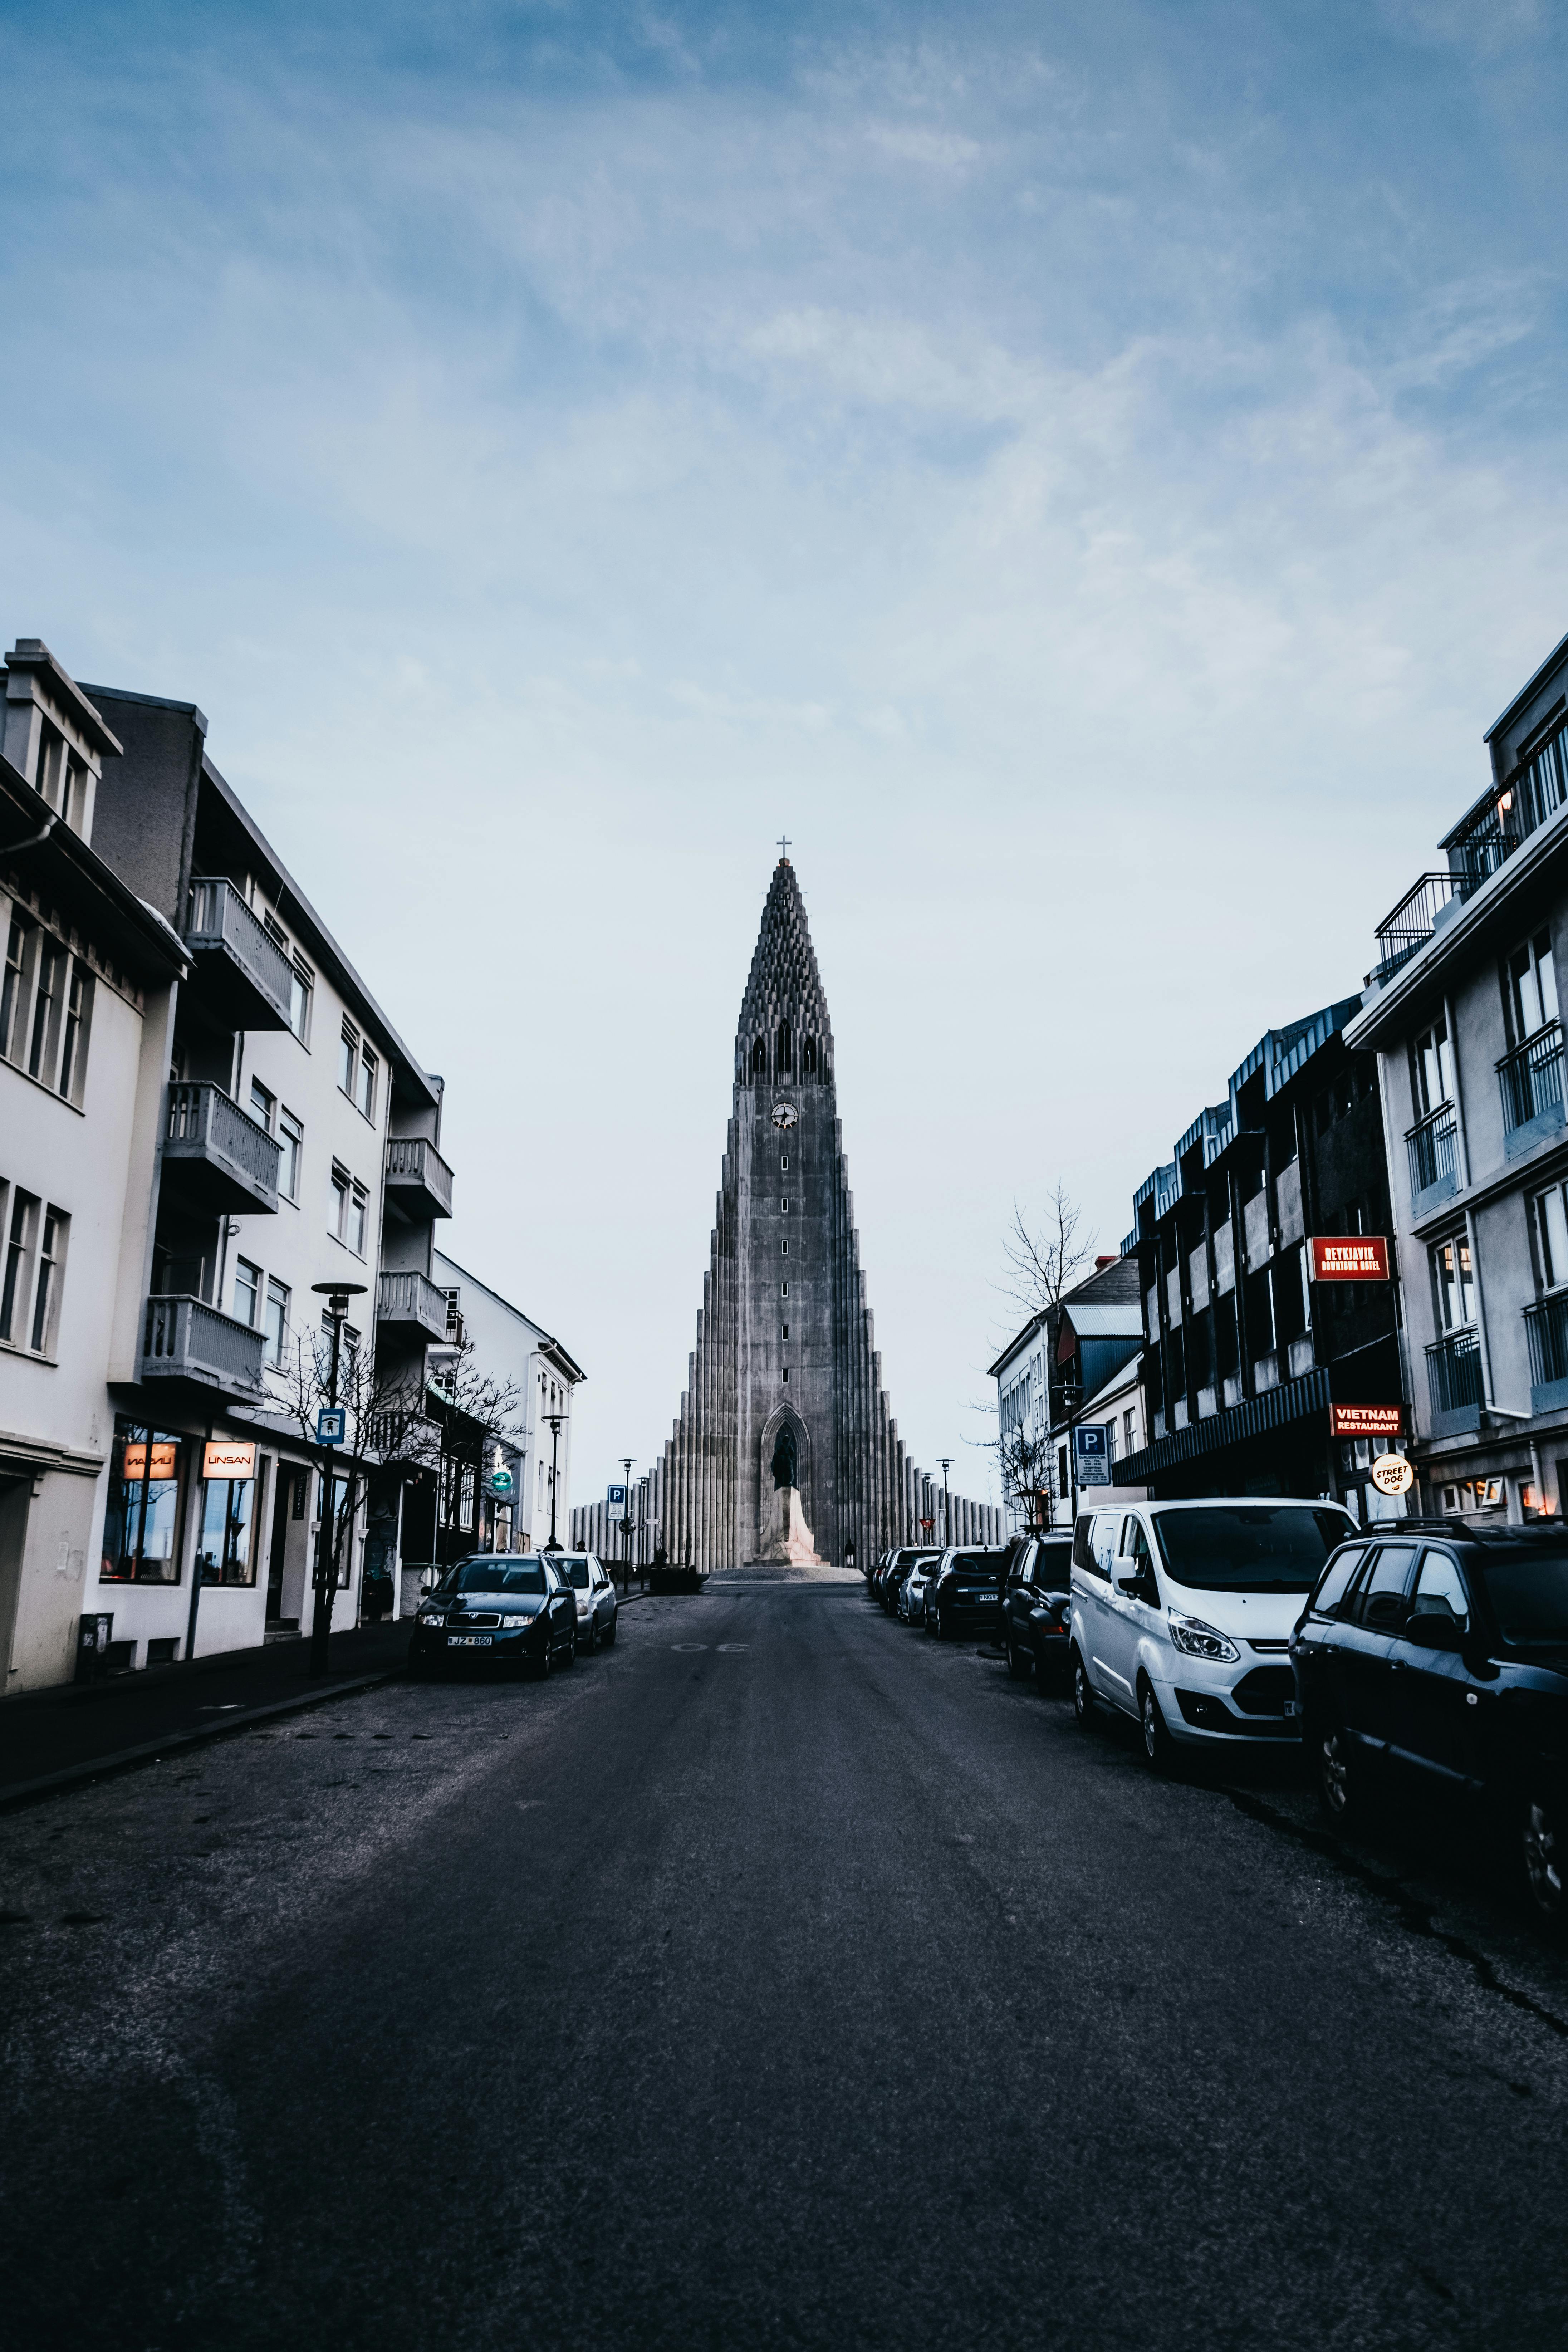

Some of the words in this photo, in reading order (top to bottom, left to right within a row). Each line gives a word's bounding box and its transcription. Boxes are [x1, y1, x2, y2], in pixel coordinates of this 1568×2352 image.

[1325, 1247, 1375, 1260] REYKJAVIK
[1322, 1261, 1358, 1271] DOWNTOWN
[1360, 1261, 1380, 1270] HOTEL
[1336, 1409, 1398, 1420] VIETNAM
[1337, 1422, 1398, 1431] RESTAURANT
[1085, 1433, 1097, 1450] P
[1377, 1465, 1408, 1478] STREET
[1384, 1475, 1403, 1484] DOG
[613, 1490, 621, 1500] P
